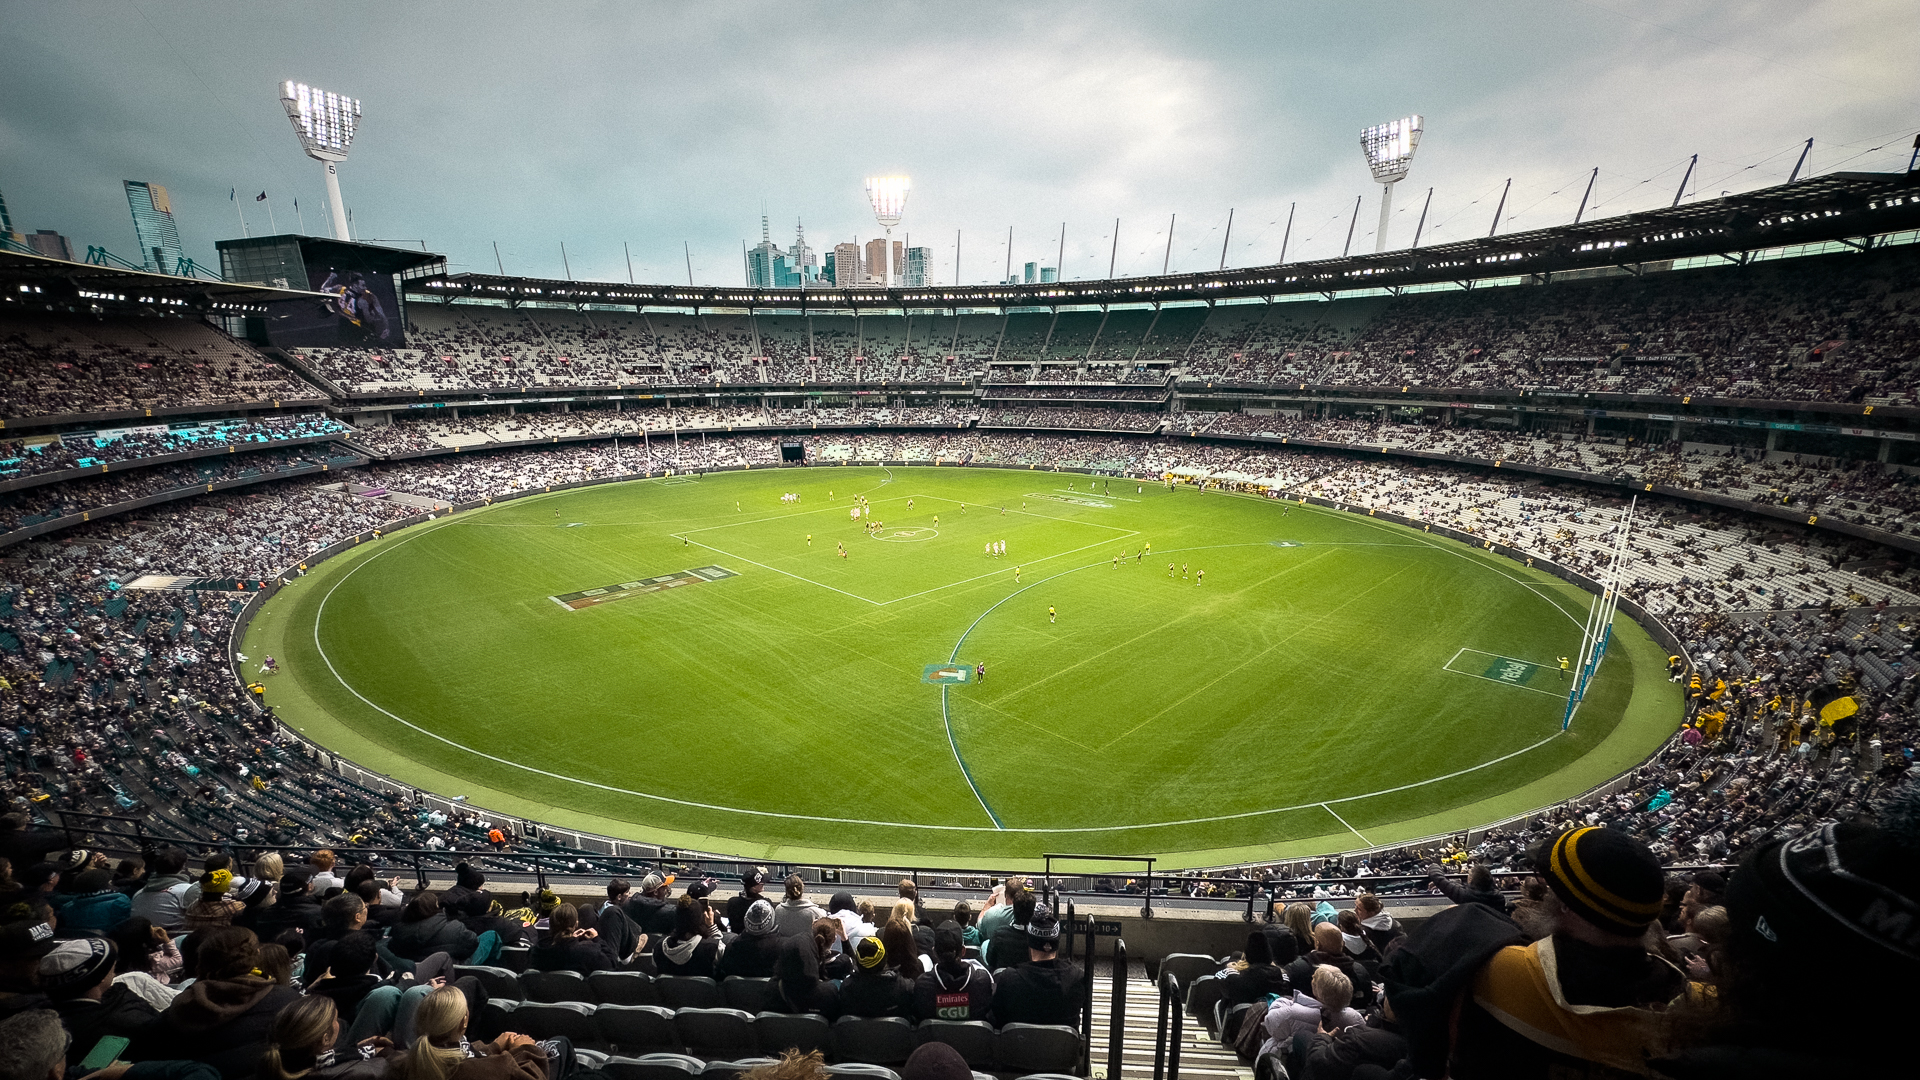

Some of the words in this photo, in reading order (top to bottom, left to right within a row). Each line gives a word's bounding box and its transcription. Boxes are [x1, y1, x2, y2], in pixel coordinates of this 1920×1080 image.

[328, 165, 336, 175] 5
[1682, 396, 1691, 405] 22
[1863, 406, 1874, 415] 22
[1776, 423, 1795, 431] OPTUS
[1645, 484, 1653, 492] 22
[1808, 516, 1818, 526] 22
[1499, 660, 1529, 683] rebel
[937, 995, 968, 1004] Emirates
[938, 1006, 968, 1018] CGU
